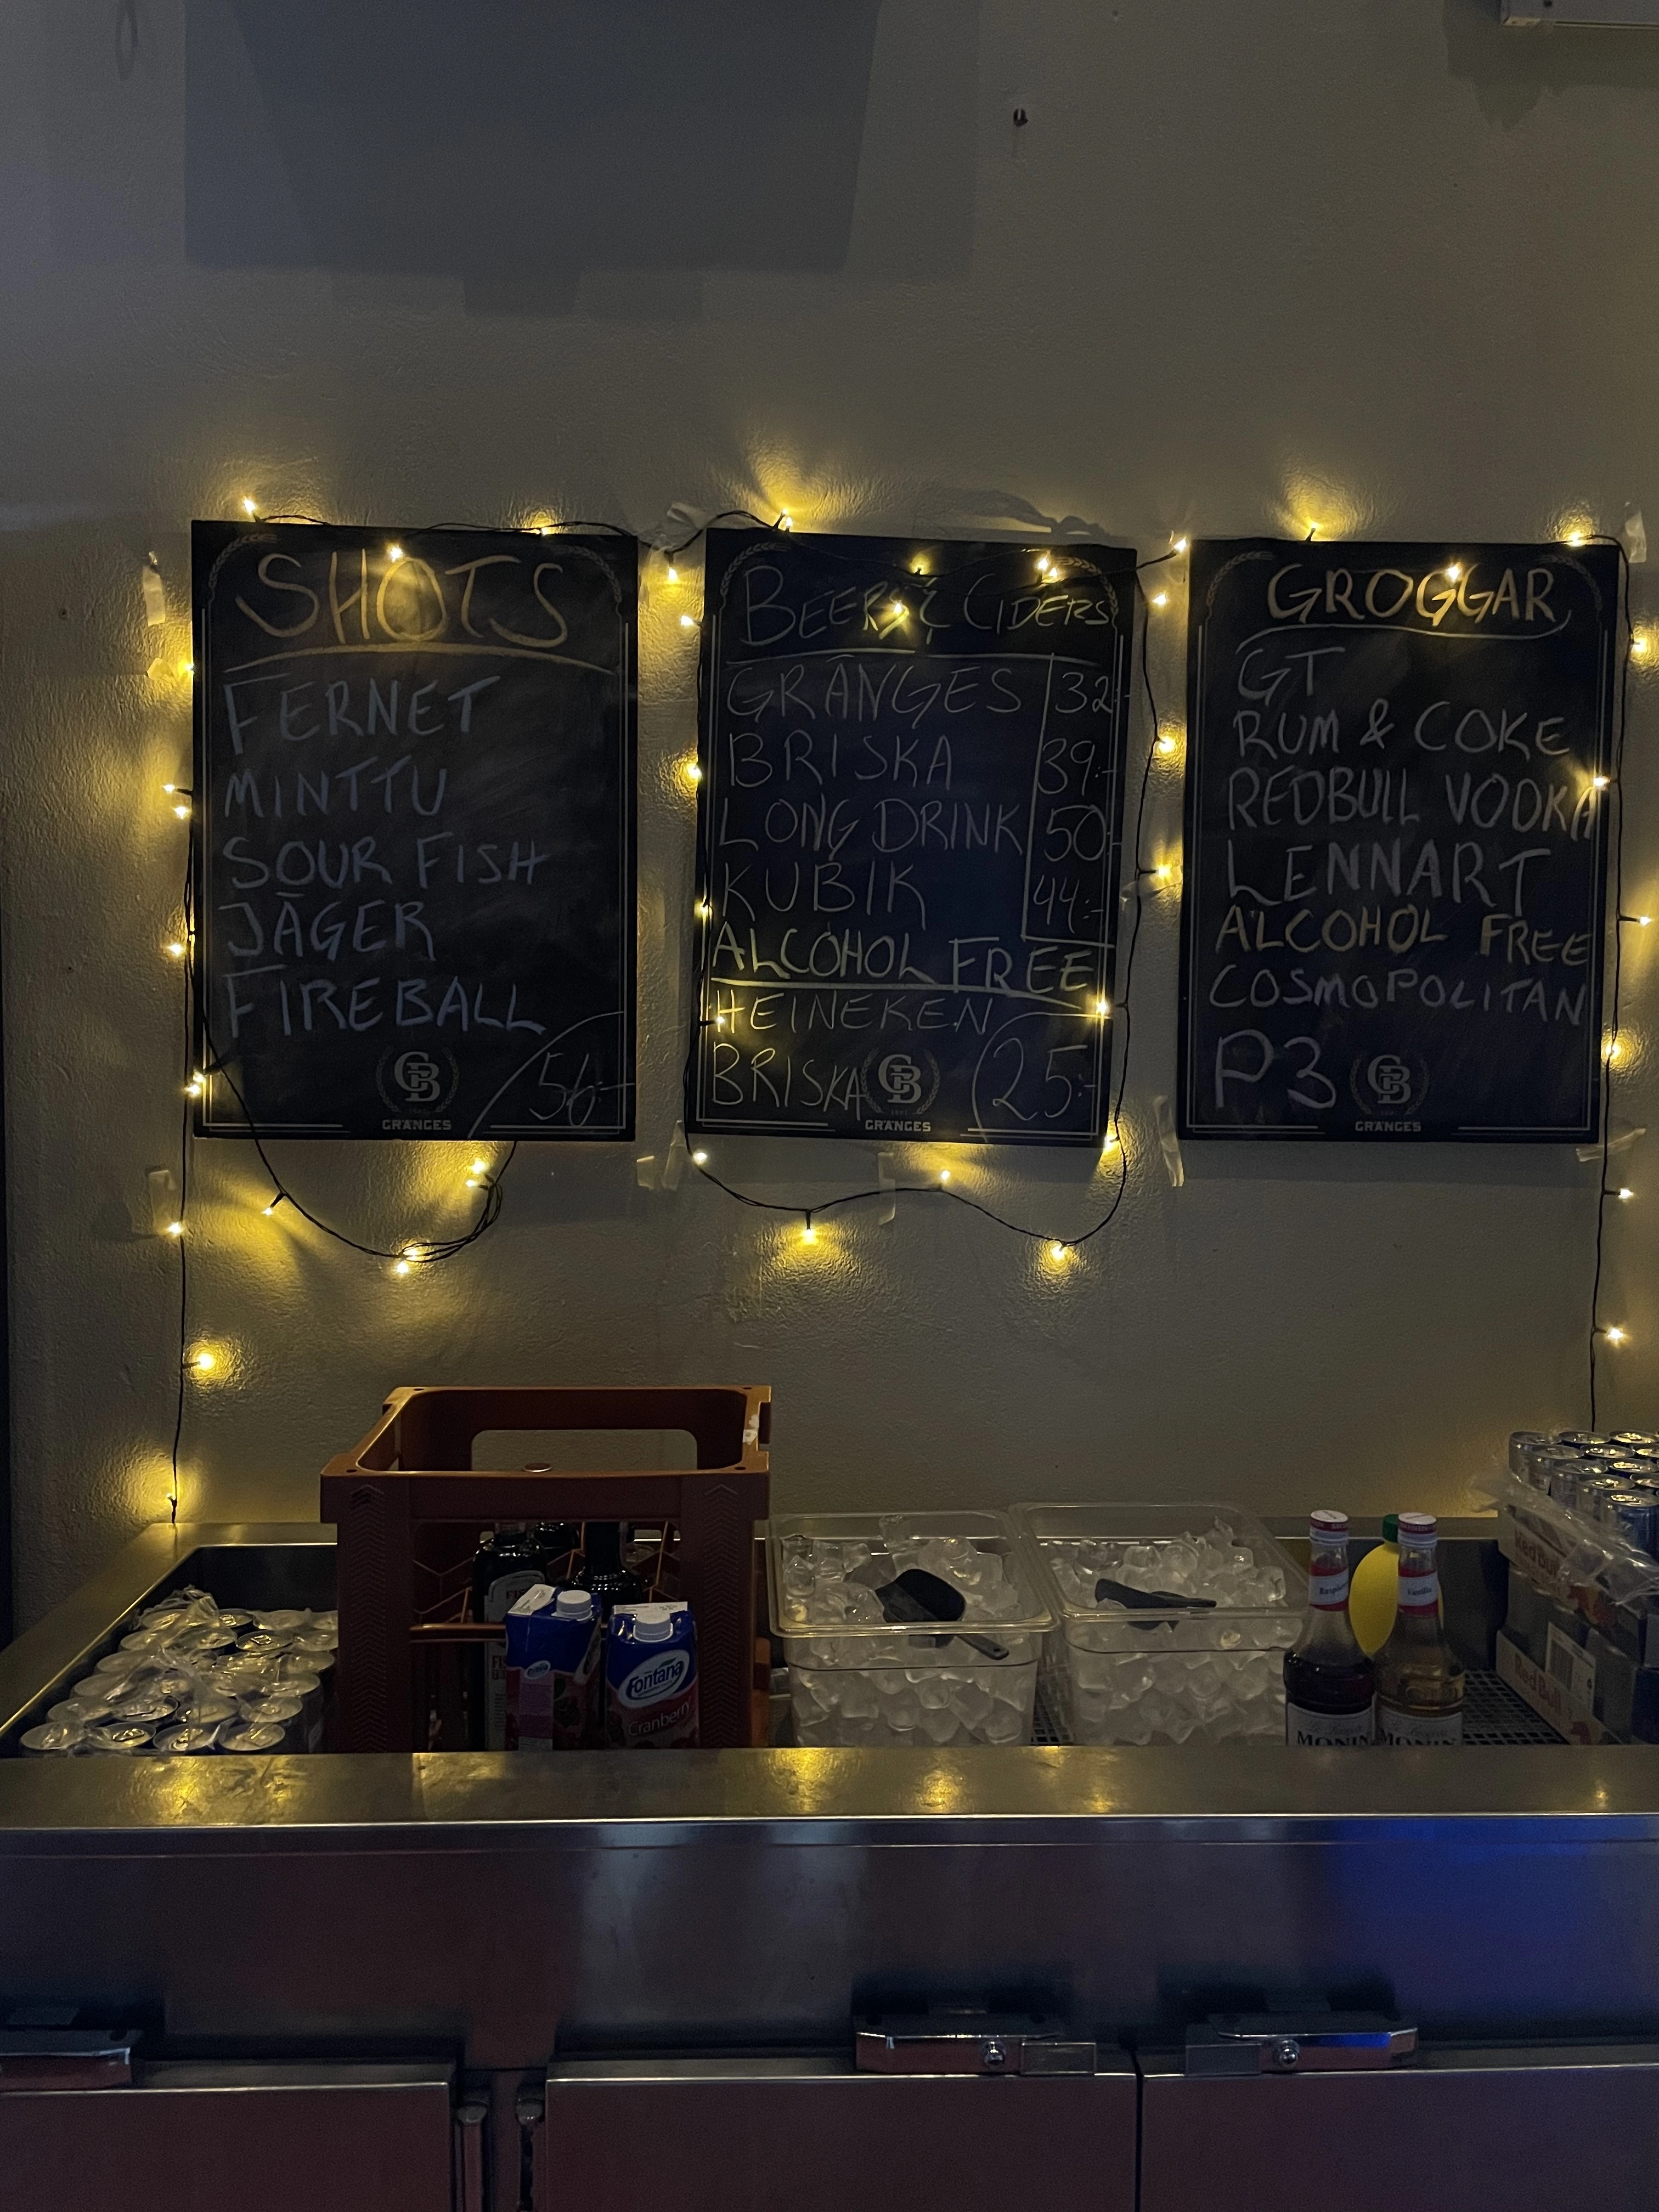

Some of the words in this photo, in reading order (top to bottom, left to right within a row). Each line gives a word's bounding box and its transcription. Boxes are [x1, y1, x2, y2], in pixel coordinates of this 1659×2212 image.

[235, 549, 567, 647] SHOTS
[741, 566, 909, 646] BEERS
[963, 573, 1111, 635] CIDERS
[1267, 563, 1556, 626] GROGGAR
[1238, 647, 1346, 706] GT
[224, 674, 501, 755] FERNET
[1233, 709, 1341, 760] RUM
[1360, 698, 1395, 749] &
[1415, 701, 1570, 761] COKE
[224, 755, 446, 818] MINTTU
[730, 729, 951, 789] BRISKA
[719, 793, 860, 860] LONG
[872, 798, 1023, 855] DRINK
[1229, 764, 1420, 831] REDBULL
[1445, 773, 1598, 841] VODKA
[223, 836, 392, 889] SOUR
[417, 832, 546, 889] FISH
[1228, 839, 1551, 917] LENNART
[723, 860, 926, 930] KUBIK
[713, 921, 939, 985] ALCOHOL
[949, 937, 1093, 994] FREE
[1216, 904, 1448, 955] ALCOHOL
[1480, 913, 1593, 966] FREE
[223, 964, 546, 1038] FIREBALL
[717, 990, 993, 1035] HEINEKEN
[1209, 964, 1587, 1026] COSMOPOLITAN
[713, 1041, 867, 1121] BRISKA
[1215, 1029, 1336, 1109] P3
[865, 1119, 932, 1132] GRÄNGES
[626, 1661, 684, 1697] Fontana
[628, 1697, 692, 1737] Cranberry
